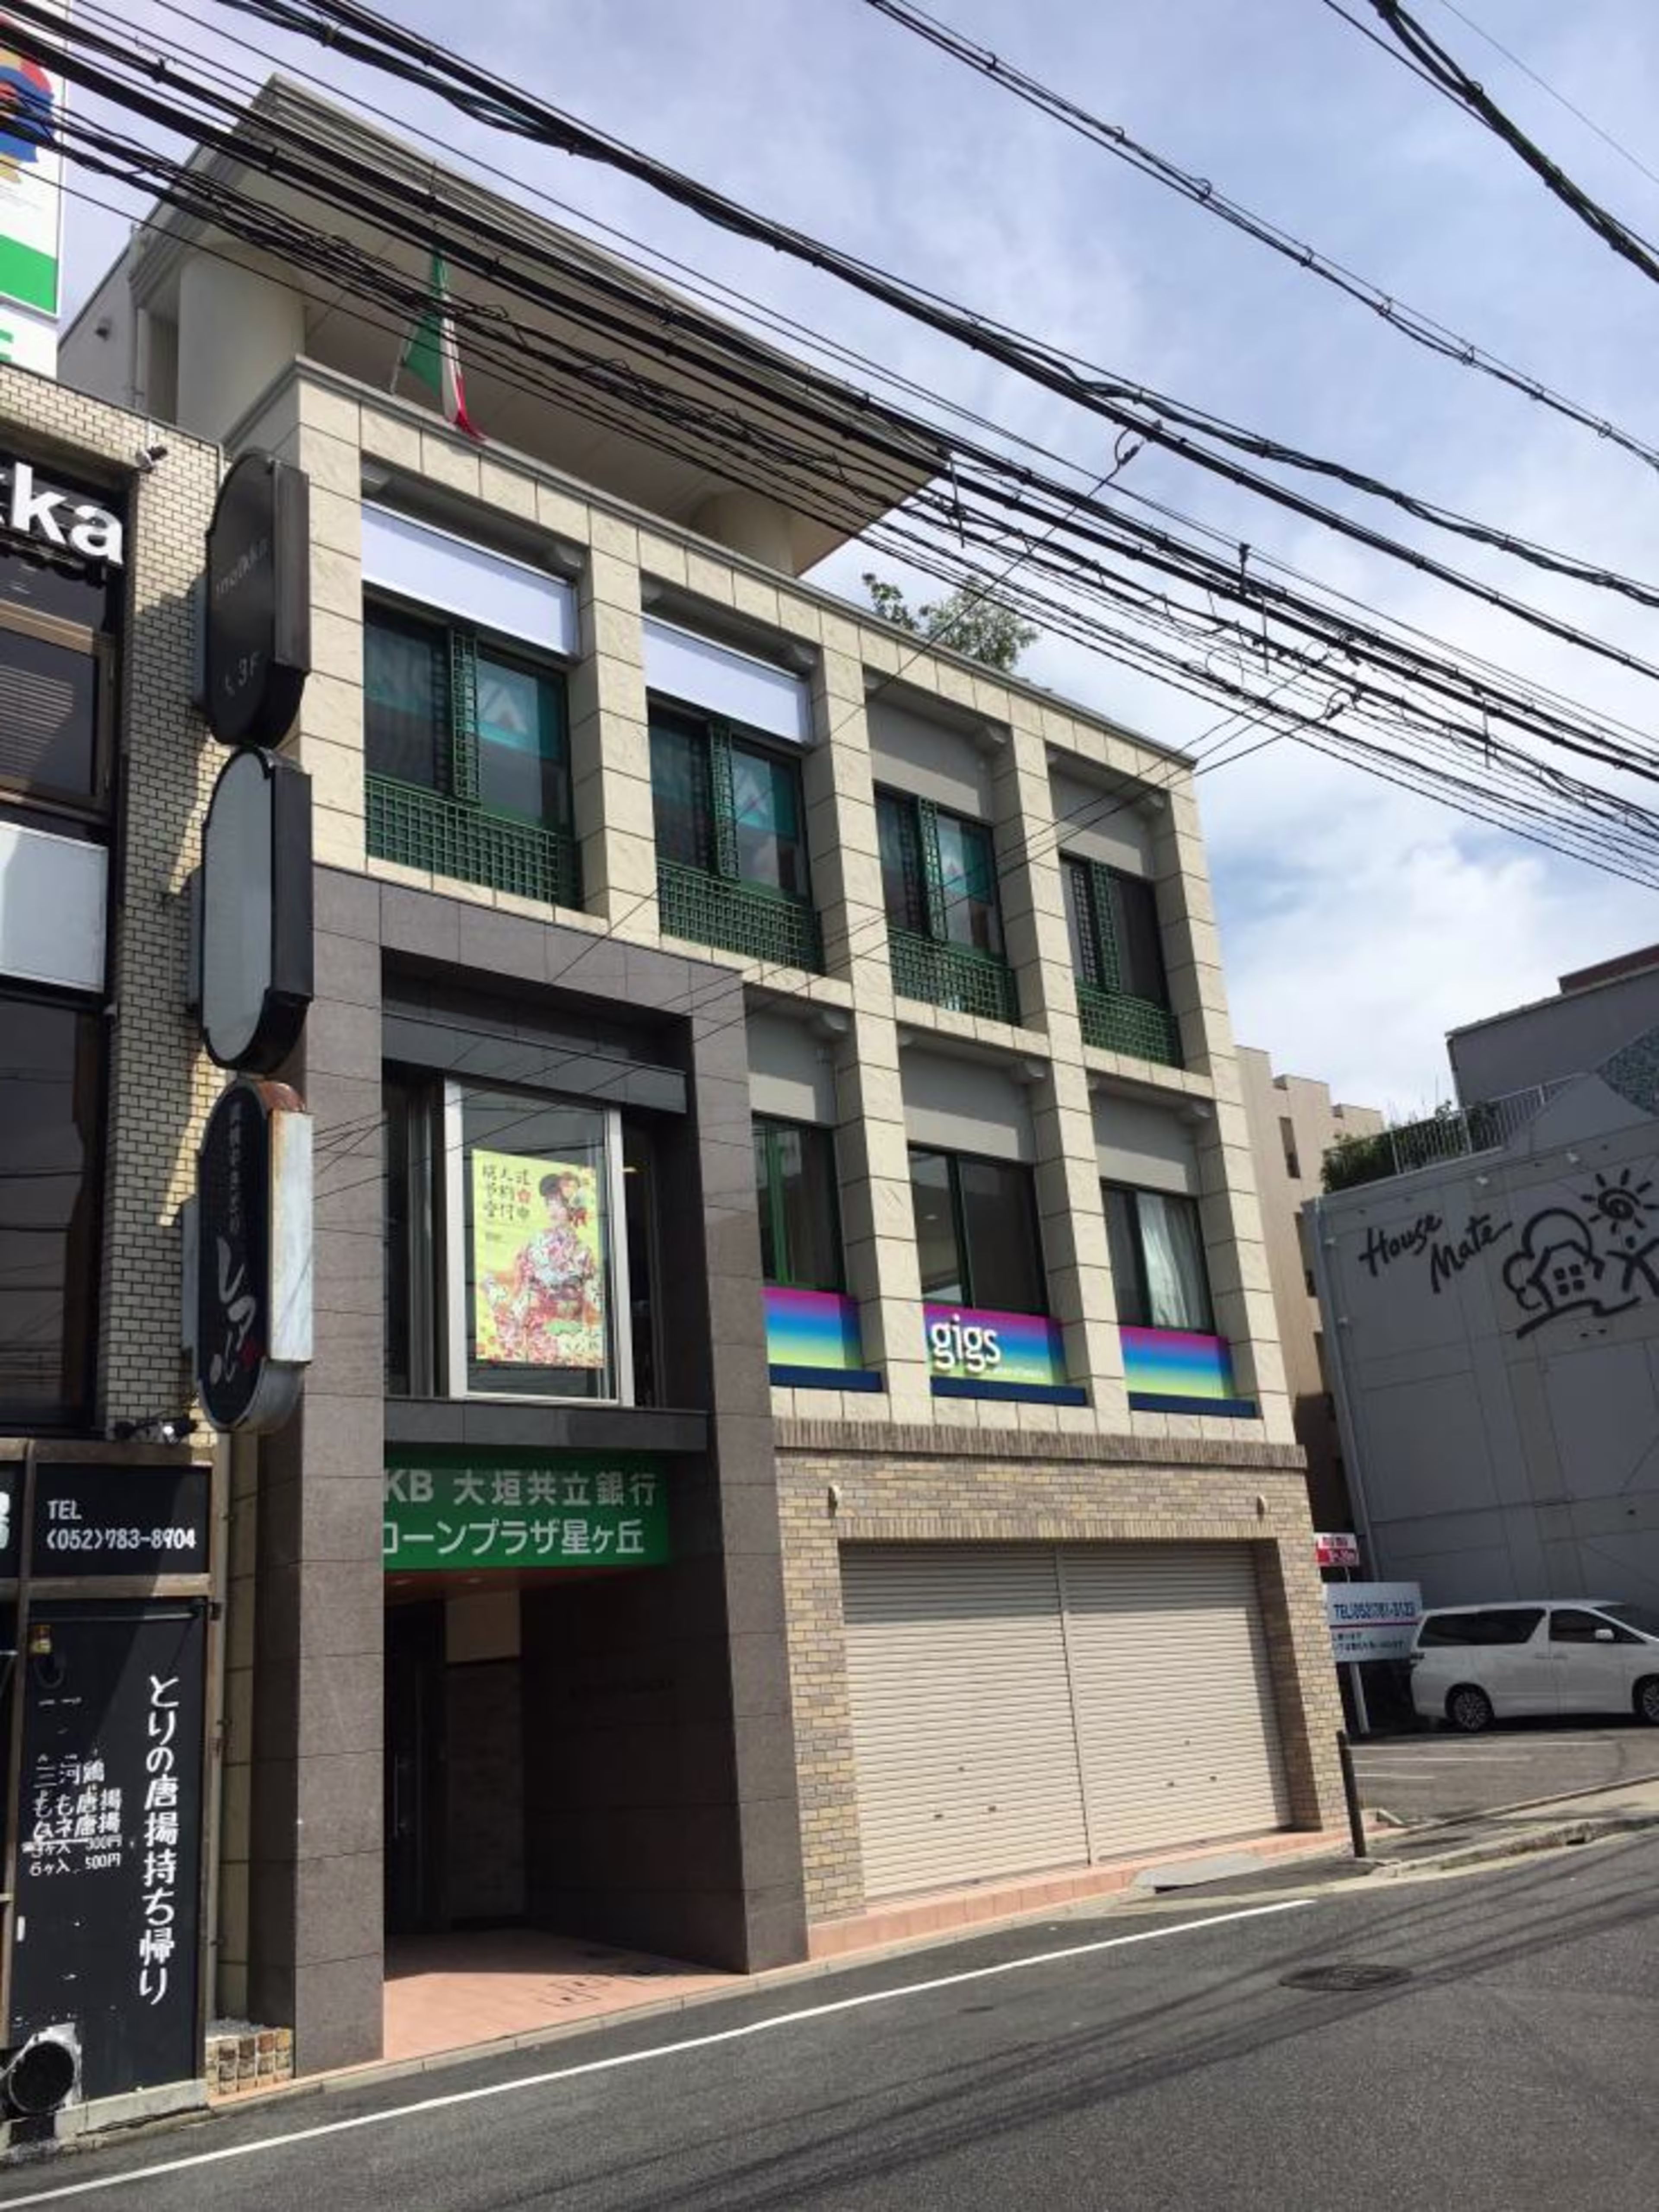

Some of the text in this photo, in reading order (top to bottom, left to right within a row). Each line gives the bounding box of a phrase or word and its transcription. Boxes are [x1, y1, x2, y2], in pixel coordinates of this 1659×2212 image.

[0, 461, 123, 565] ka
[1358, 1214, 1443, 1277] House
[1431, 1213, 1513, 1294] Mate
[931, 1313, 1001, 1373] gigs
[48, 1500, 82, 1520] TEL
[453, 1468, 657, 1507] 大垣共立銀行
[139, 1674, 179, 2005] とりの唐揚持ち帰り
